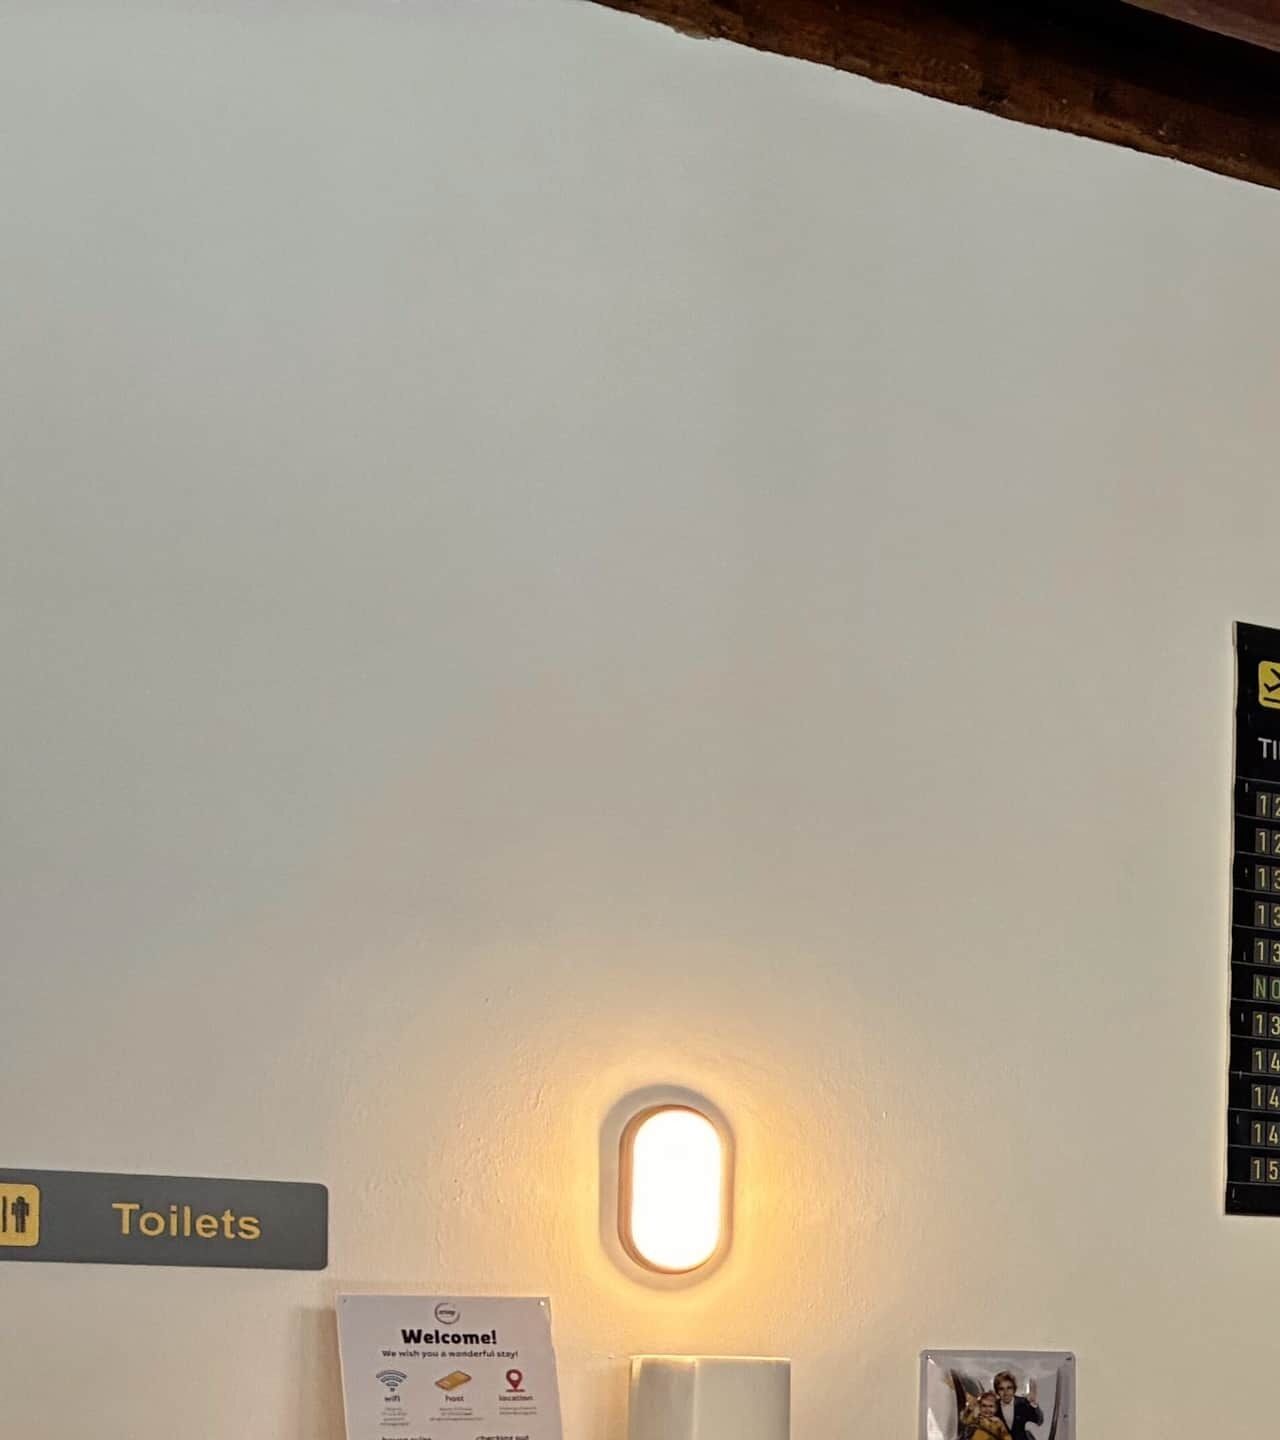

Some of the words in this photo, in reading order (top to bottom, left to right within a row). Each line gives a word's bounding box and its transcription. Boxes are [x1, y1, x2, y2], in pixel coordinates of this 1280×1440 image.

[112, 1202, 262, 1240] Toilets
[401, 1329, 497, 1345] Welcome!
[399, 1349, 420, 1358] wish
[422, 1350, 440, 1360] you
[449, 1349, 495, 1358] wonderful
